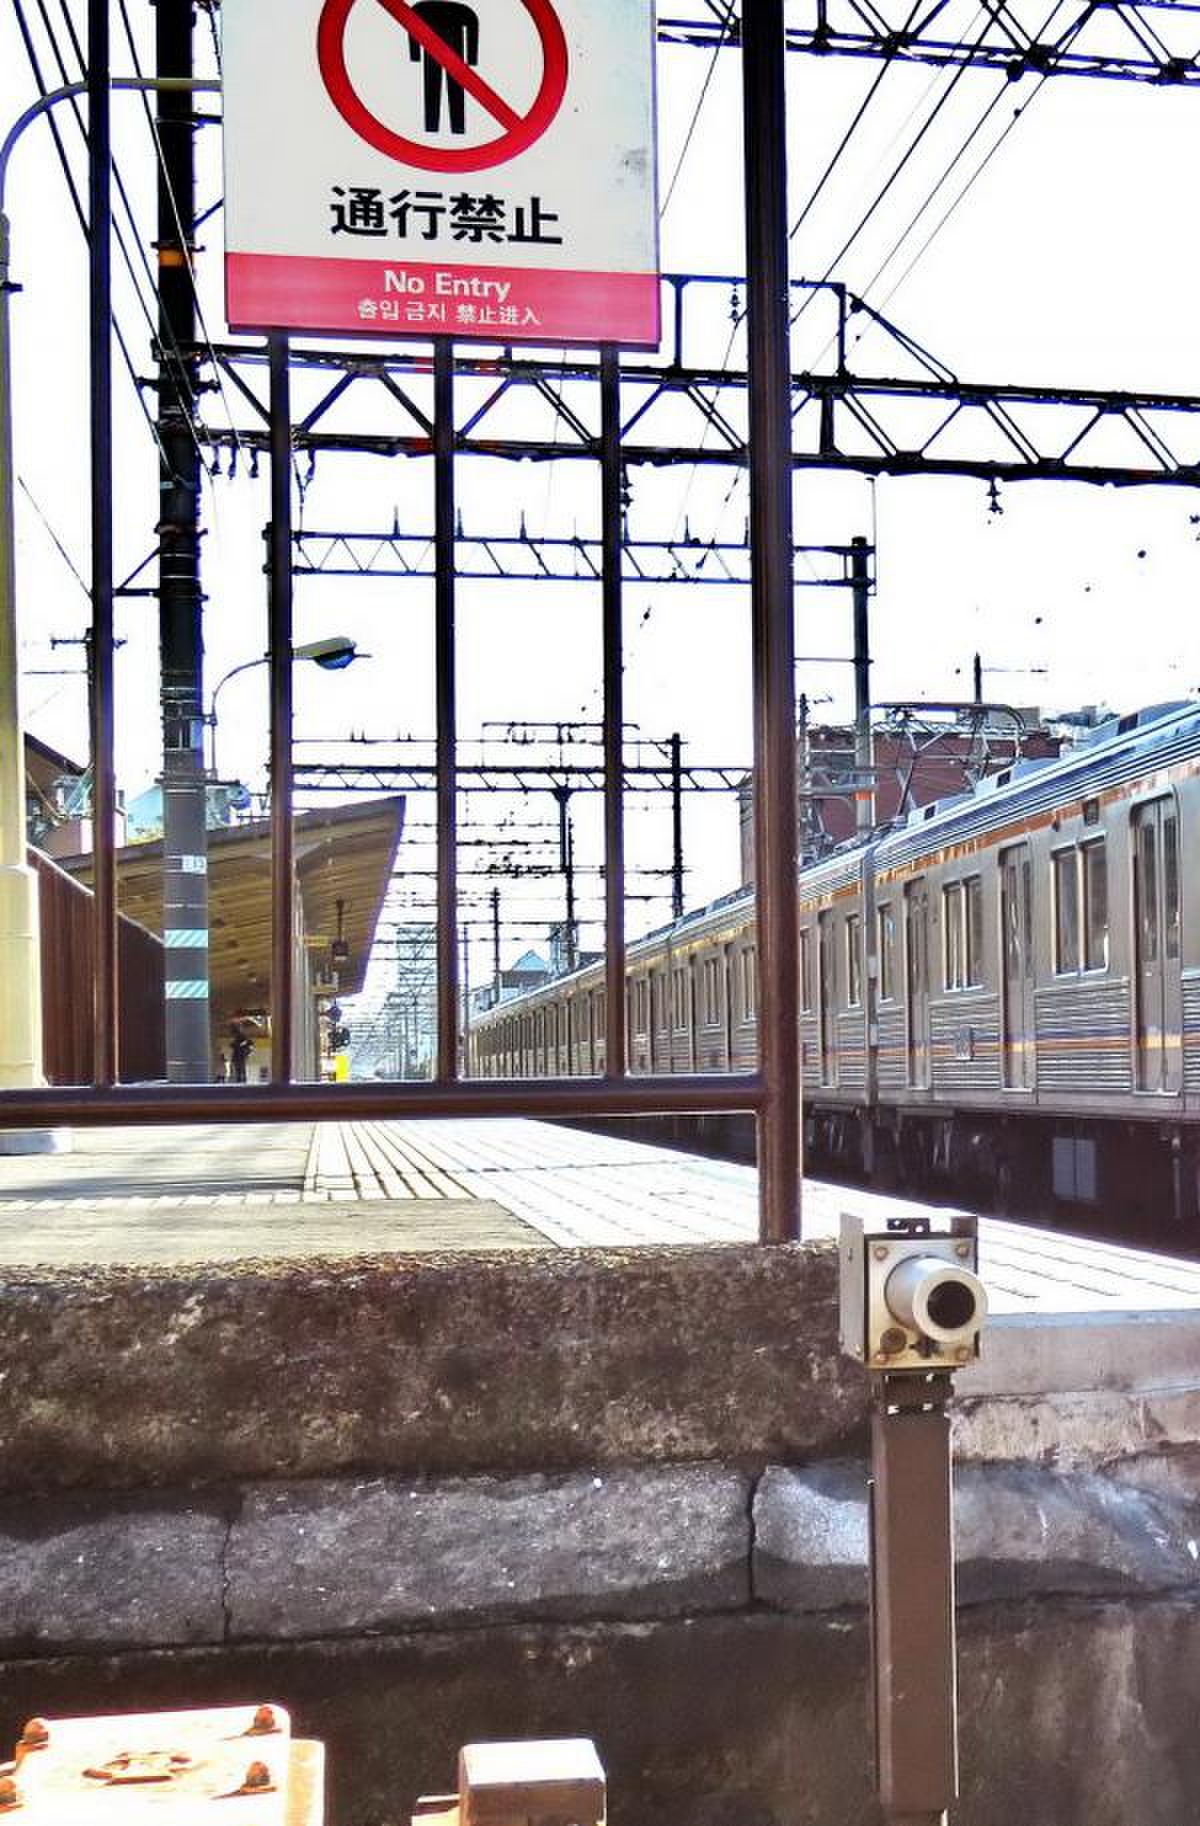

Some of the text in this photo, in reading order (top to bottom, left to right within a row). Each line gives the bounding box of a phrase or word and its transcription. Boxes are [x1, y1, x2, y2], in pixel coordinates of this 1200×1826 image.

[330, 186, 563, 245] 通行禁止
[384, 269, 511, 302] No Entry
